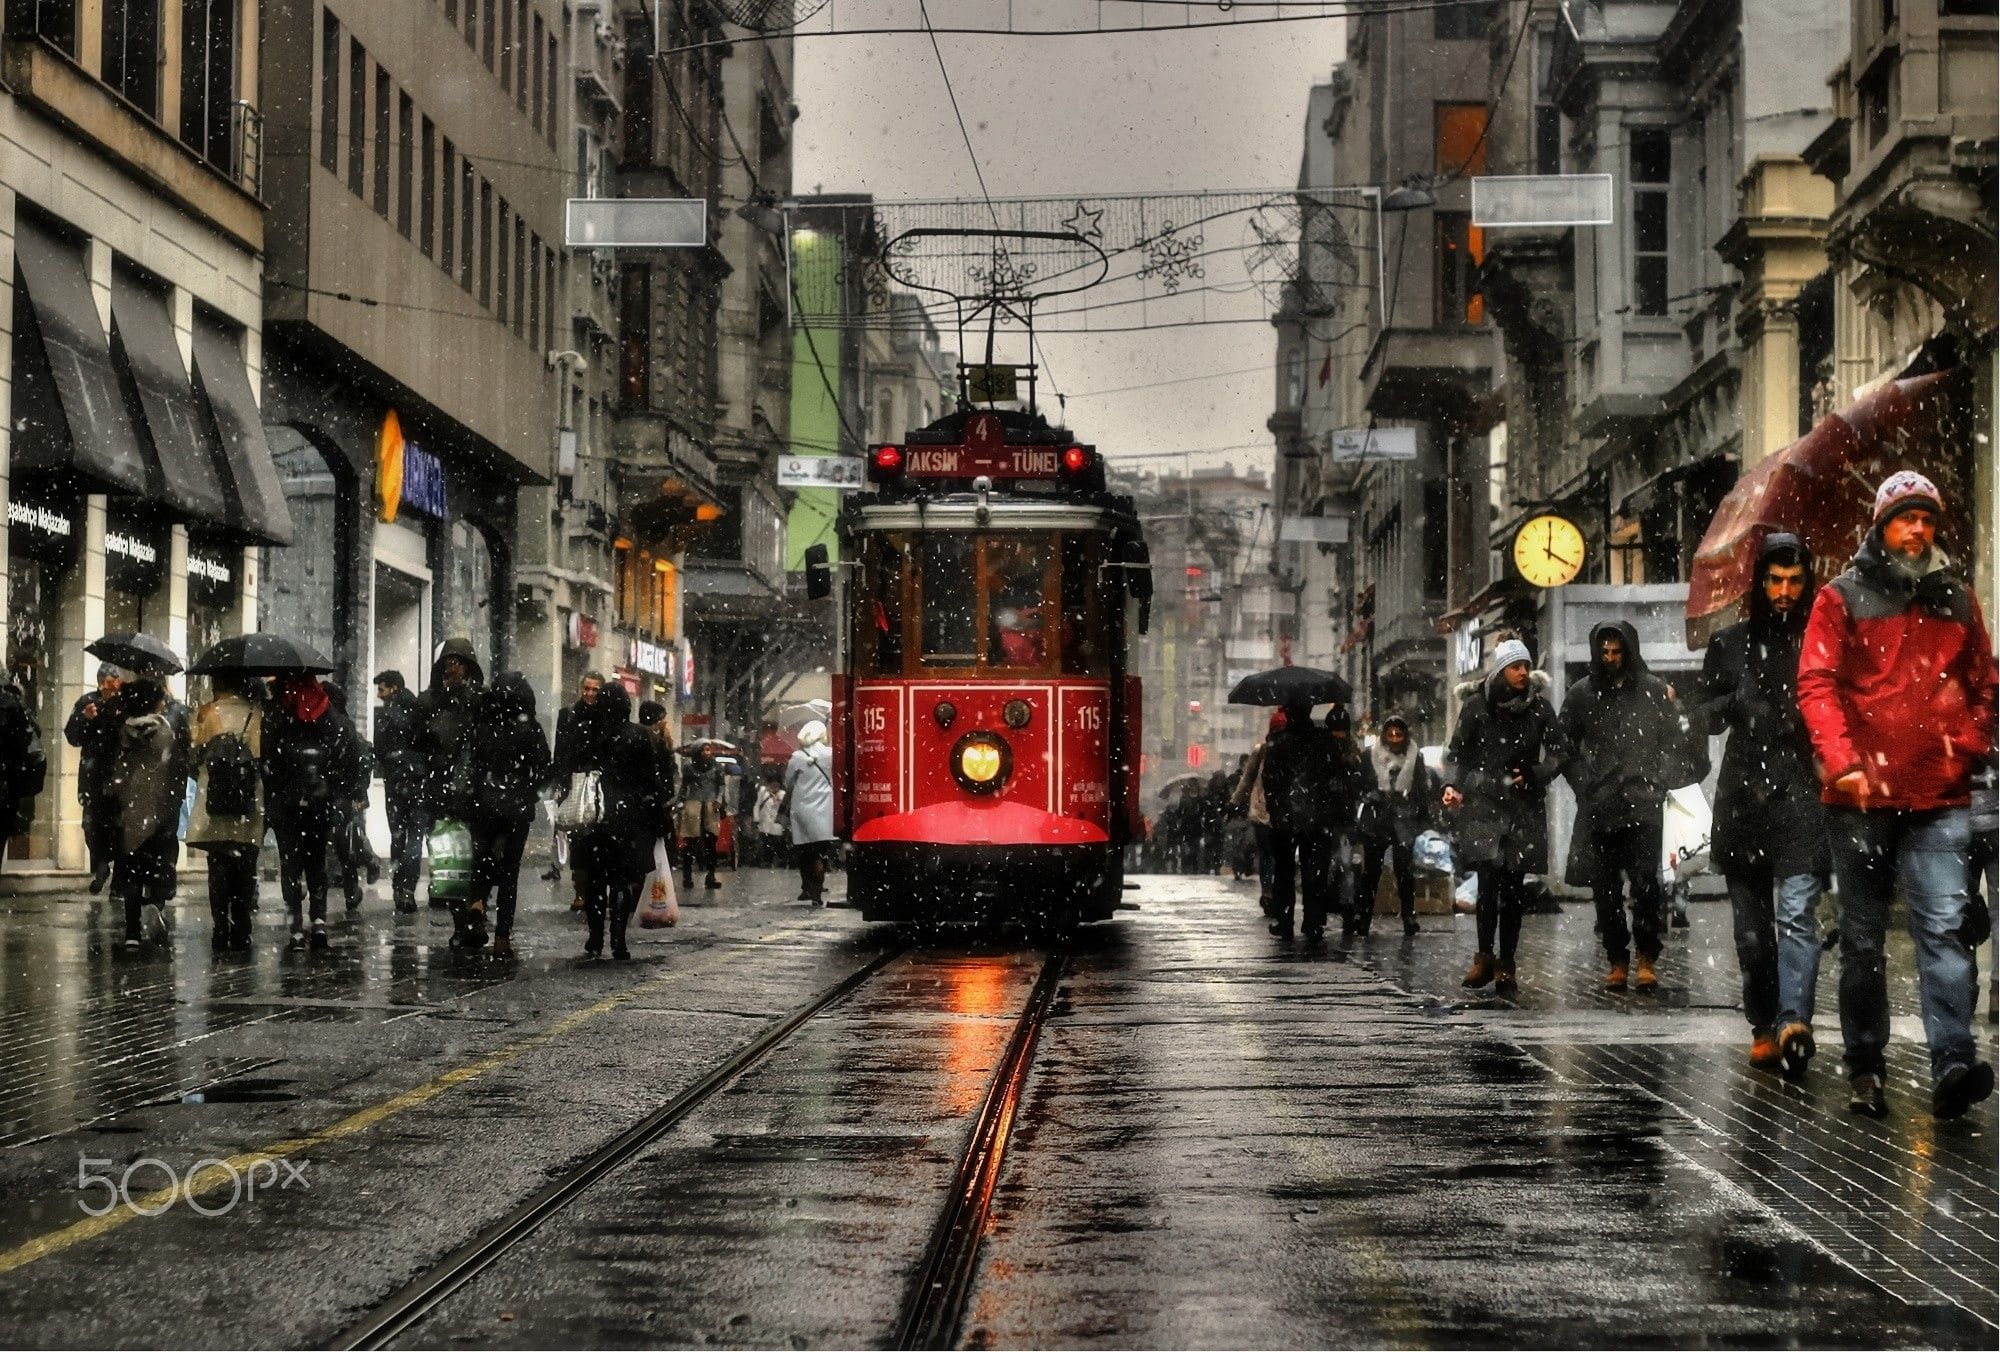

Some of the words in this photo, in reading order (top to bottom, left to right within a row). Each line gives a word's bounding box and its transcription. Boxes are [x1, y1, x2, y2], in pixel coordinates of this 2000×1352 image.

[975, 417, 988, 442] 4
[905, 448, 958, 472] TAKSİM
[8, 500, 37, 531] aşabahçe
[863, 707, 885, 731] 115
[1078, 706, 1100, 730] 115
